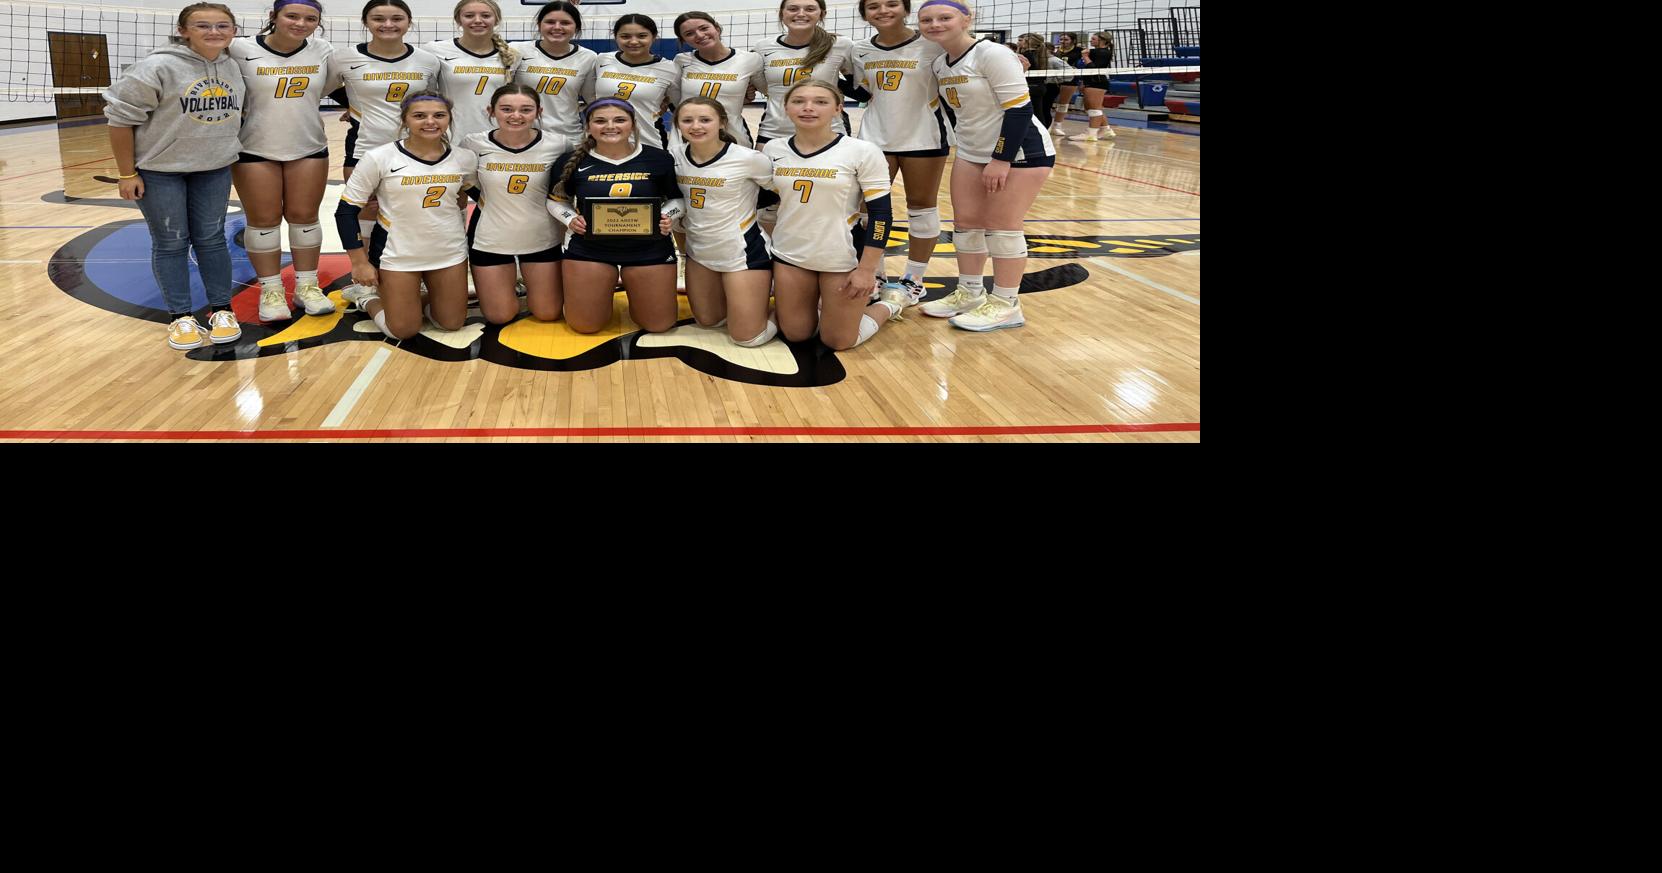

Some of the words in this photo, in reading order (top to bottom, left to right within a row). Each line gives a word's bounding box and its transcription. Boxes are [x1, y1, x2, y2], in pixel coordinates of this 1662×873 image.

[256, 65, 320, 75] RIVERSIDE
[363, 72, 424, 81] RIVERSIDE
[526, 65, 579, 76] RIVERSIDE
[601, 71, 658, 84] RIVERSIDE
[274, 76, 310, 99] 12
[475, 76, 489, 95] 1
[535, 76, 567, 95] 10
[876, 71, 903, 91] 13
[385, 82, 410, 102] 8
[614, 82, 636, 101] 3
[700, 82, 722, 100] 11
[945, 87, 961, 108] 4
[179, 94, 240, 114] VOLLEYBALL
[486, 162, 547, 173] RIVERSIDE
[588, 172, 651, 182] RIVERSIDE
[775, 167, 838, 179] RIVERSIDE
[401, 174, 462, 185] RIVERSIDE
[507, 175, 529, 194] 6
[422, 186, 447, 208] 2
[689, 188, 706, 209] 5
[793, 180, 814, 203] 7
